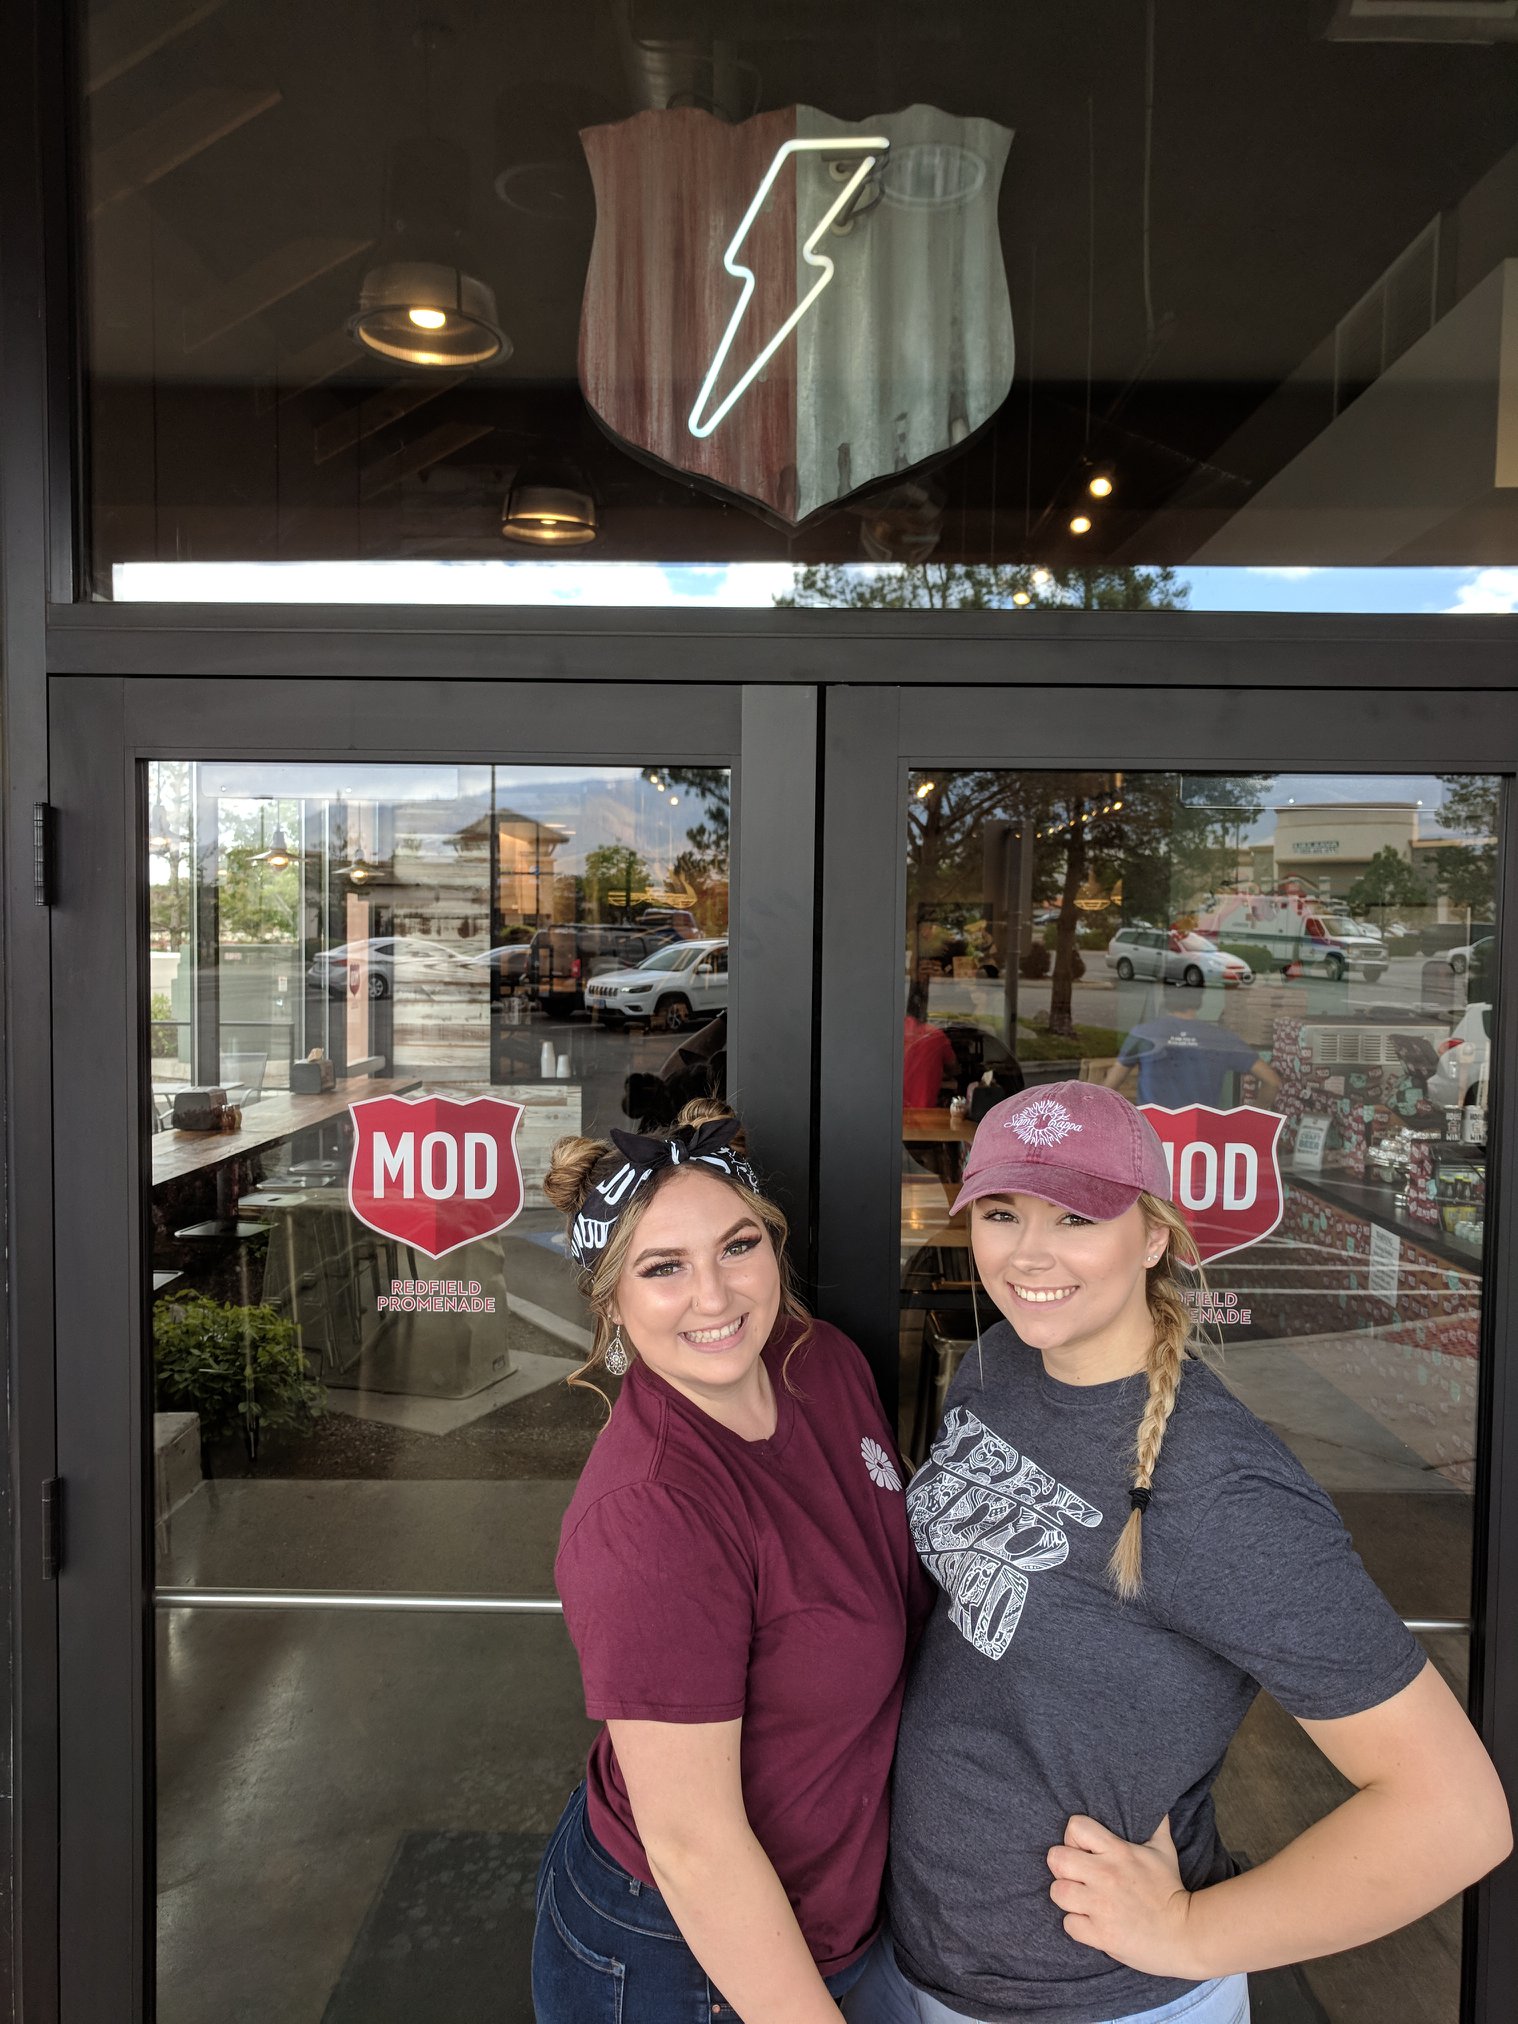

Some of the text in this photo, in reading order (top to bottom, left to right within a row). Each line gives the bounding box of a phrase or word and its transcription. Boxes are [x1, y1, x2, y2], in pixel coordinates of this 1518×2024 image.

[1003, 1113, 1084, 1132] Sigma Kappa
[373, 1131, 498, 1200] MOD
[391, 1279, 482, 1296] REDFIELD
[377, 1296, 496, 1313] PROMENADE
[1180, 1292, 1238, 1308] FIELD
[1189, 1308, 1252, 1325] ENADE
